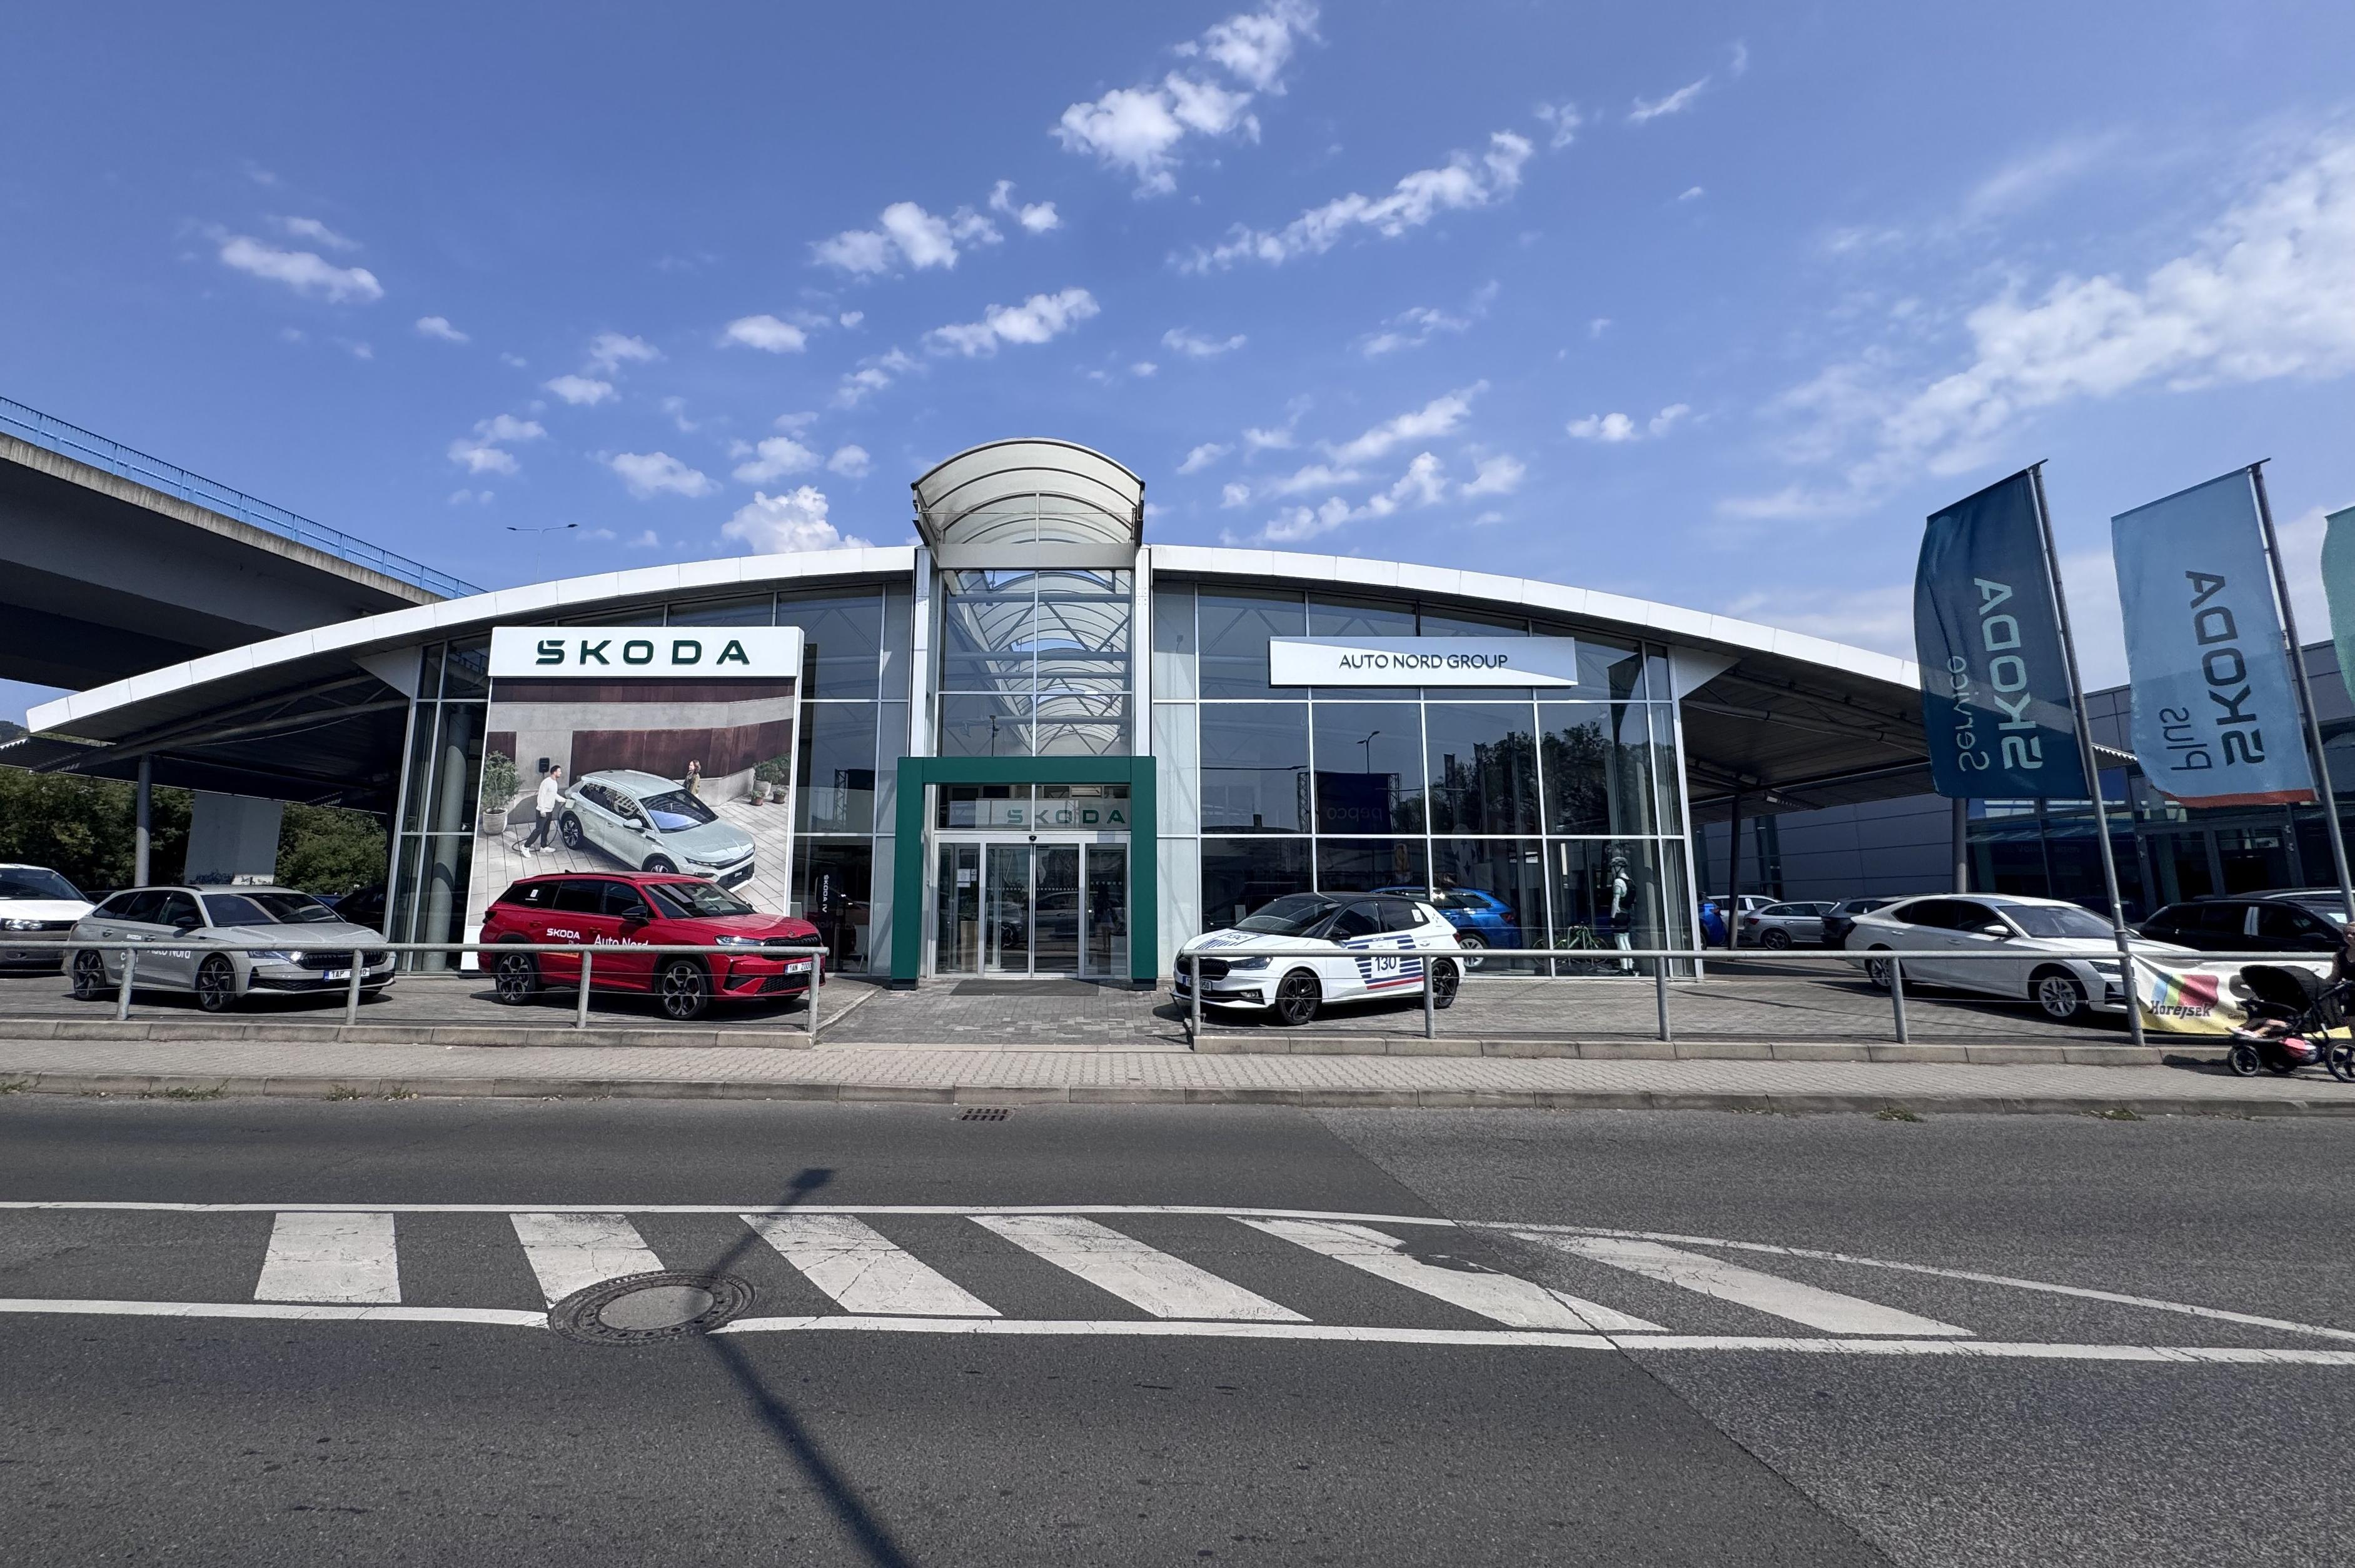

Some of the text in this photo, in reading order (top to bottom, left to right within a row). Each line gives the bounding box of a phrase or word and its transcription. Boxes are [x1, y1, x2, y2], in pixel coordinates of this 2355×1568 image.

[1339, 655, 1508, 669] AUTO NORD GROUP
[594, 933, 620, 945] Auto
[1375, 957, 1396, 972] 130
